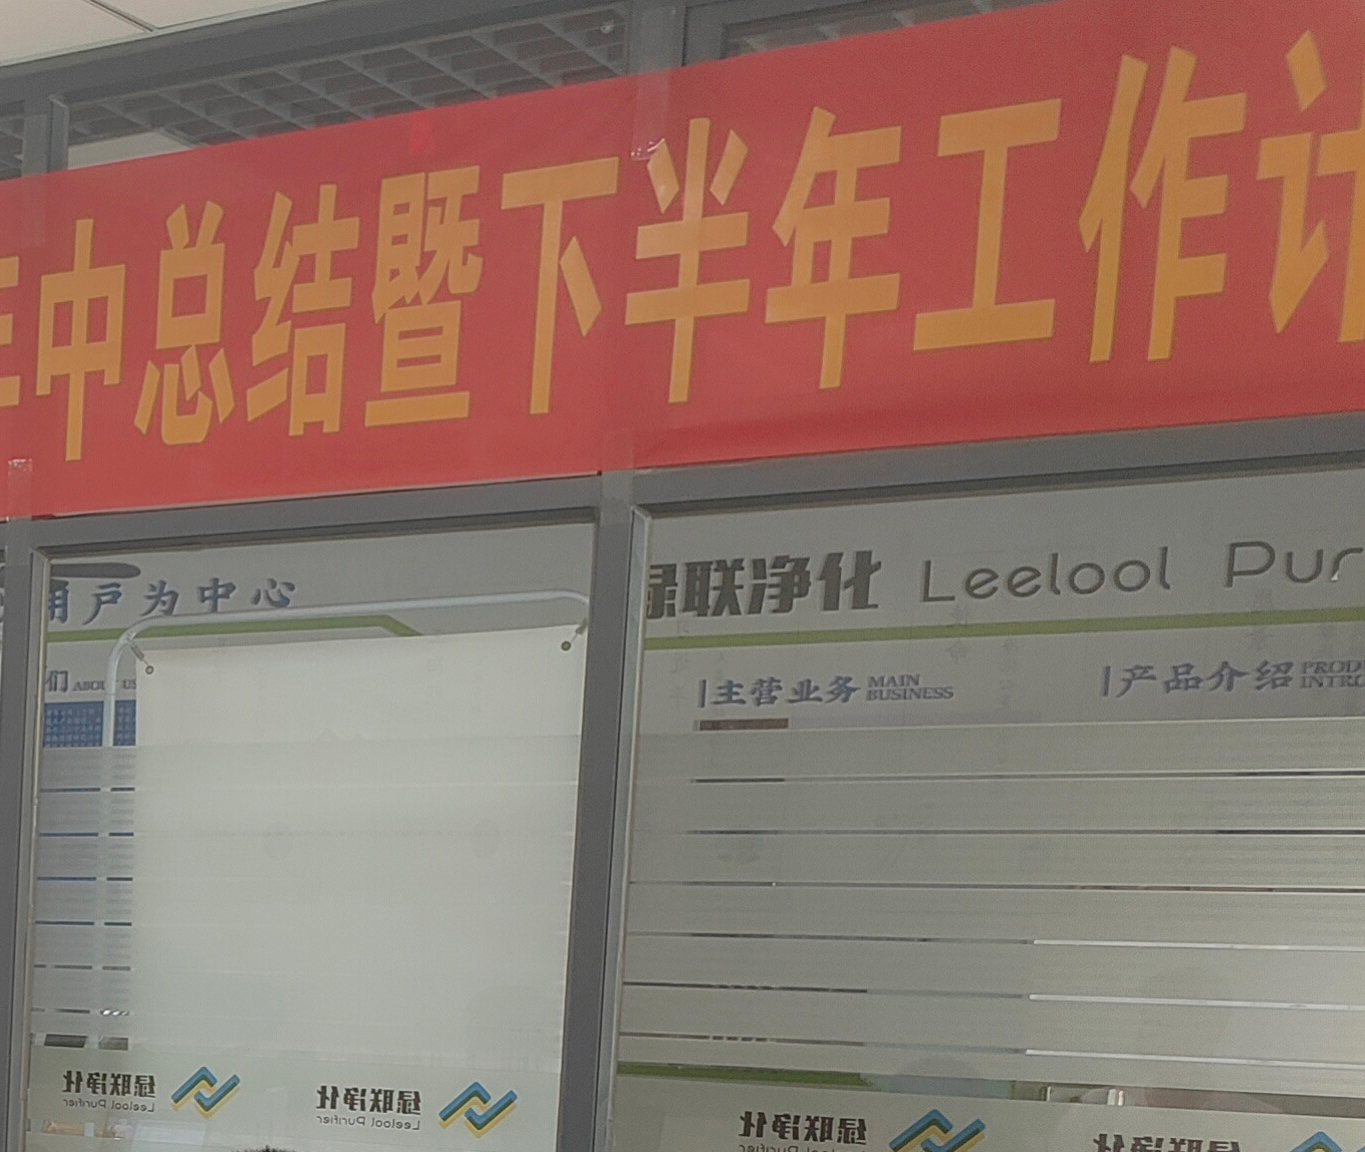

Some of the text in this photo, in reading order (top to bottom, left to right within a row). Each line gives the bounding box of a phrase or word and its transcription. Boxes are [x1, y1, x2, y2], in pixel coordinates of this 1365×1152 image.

[921, 546, 1171, 603] Leelool
[1117, 660, 1294, 698] 产品介绍
[1302, 659, 1365, 675] PROD
[712, 675, 861, 708] 主营业务
[869, 673, 921, 689] MAIN
[868, 686, 955, 701] BUSINESS
